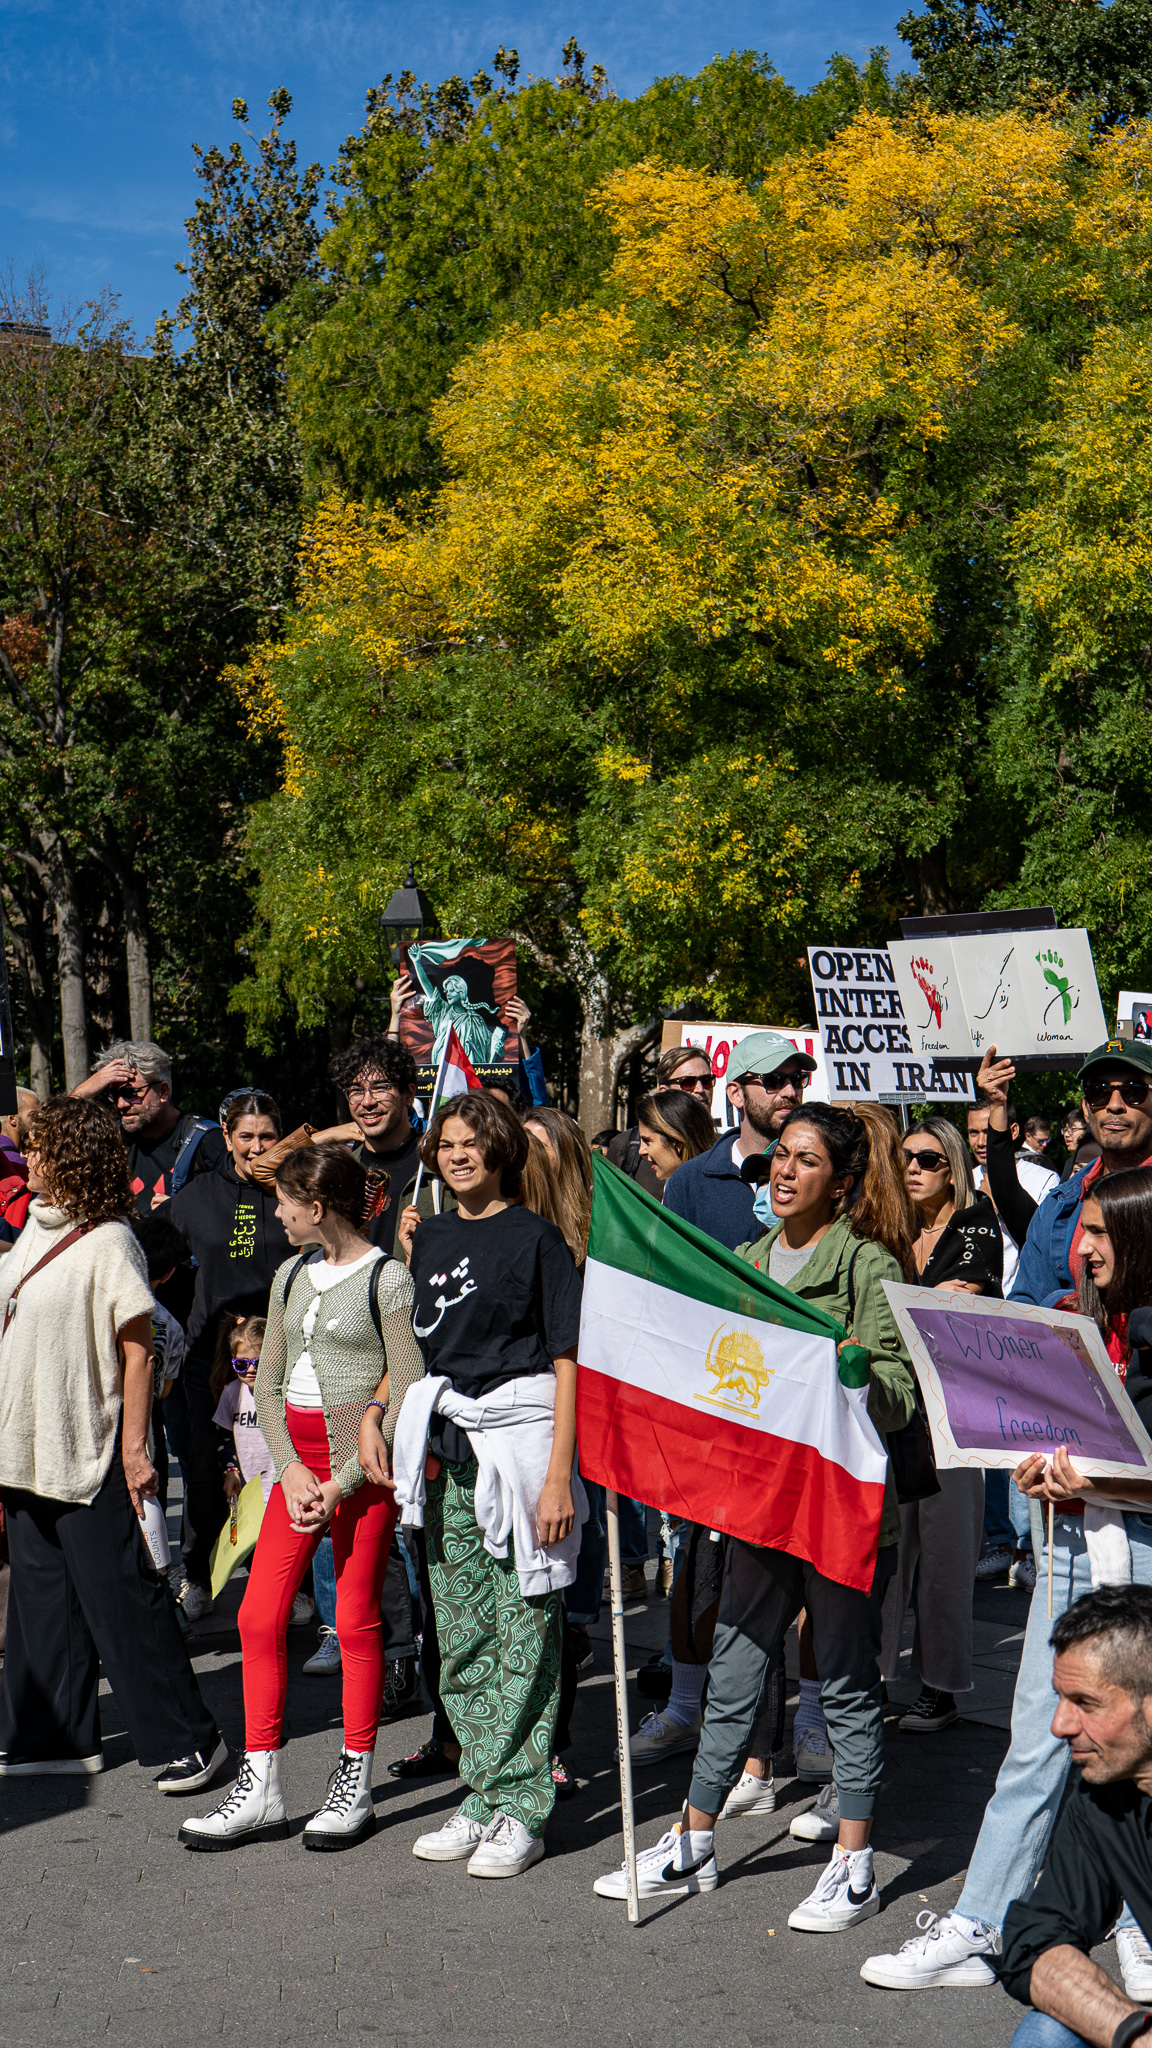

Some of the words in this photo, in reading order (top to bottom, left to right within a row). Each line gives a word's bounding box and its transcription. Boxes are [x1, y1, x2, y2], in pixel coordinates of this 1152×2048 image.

[812, 950, 896, 983] OPEN
[833, 1061, 871, 1092] IN
[892, 1062, 969, 1094] IRAN
[233, 1220, 256, 1235] زن
[413, 1256, 478, 1338] عشق
[946, 1318, 1044, 1361] Women
[995, 1396, 1082, 1447] freedom
[149, 1530, 162, 1566] COUNTS
